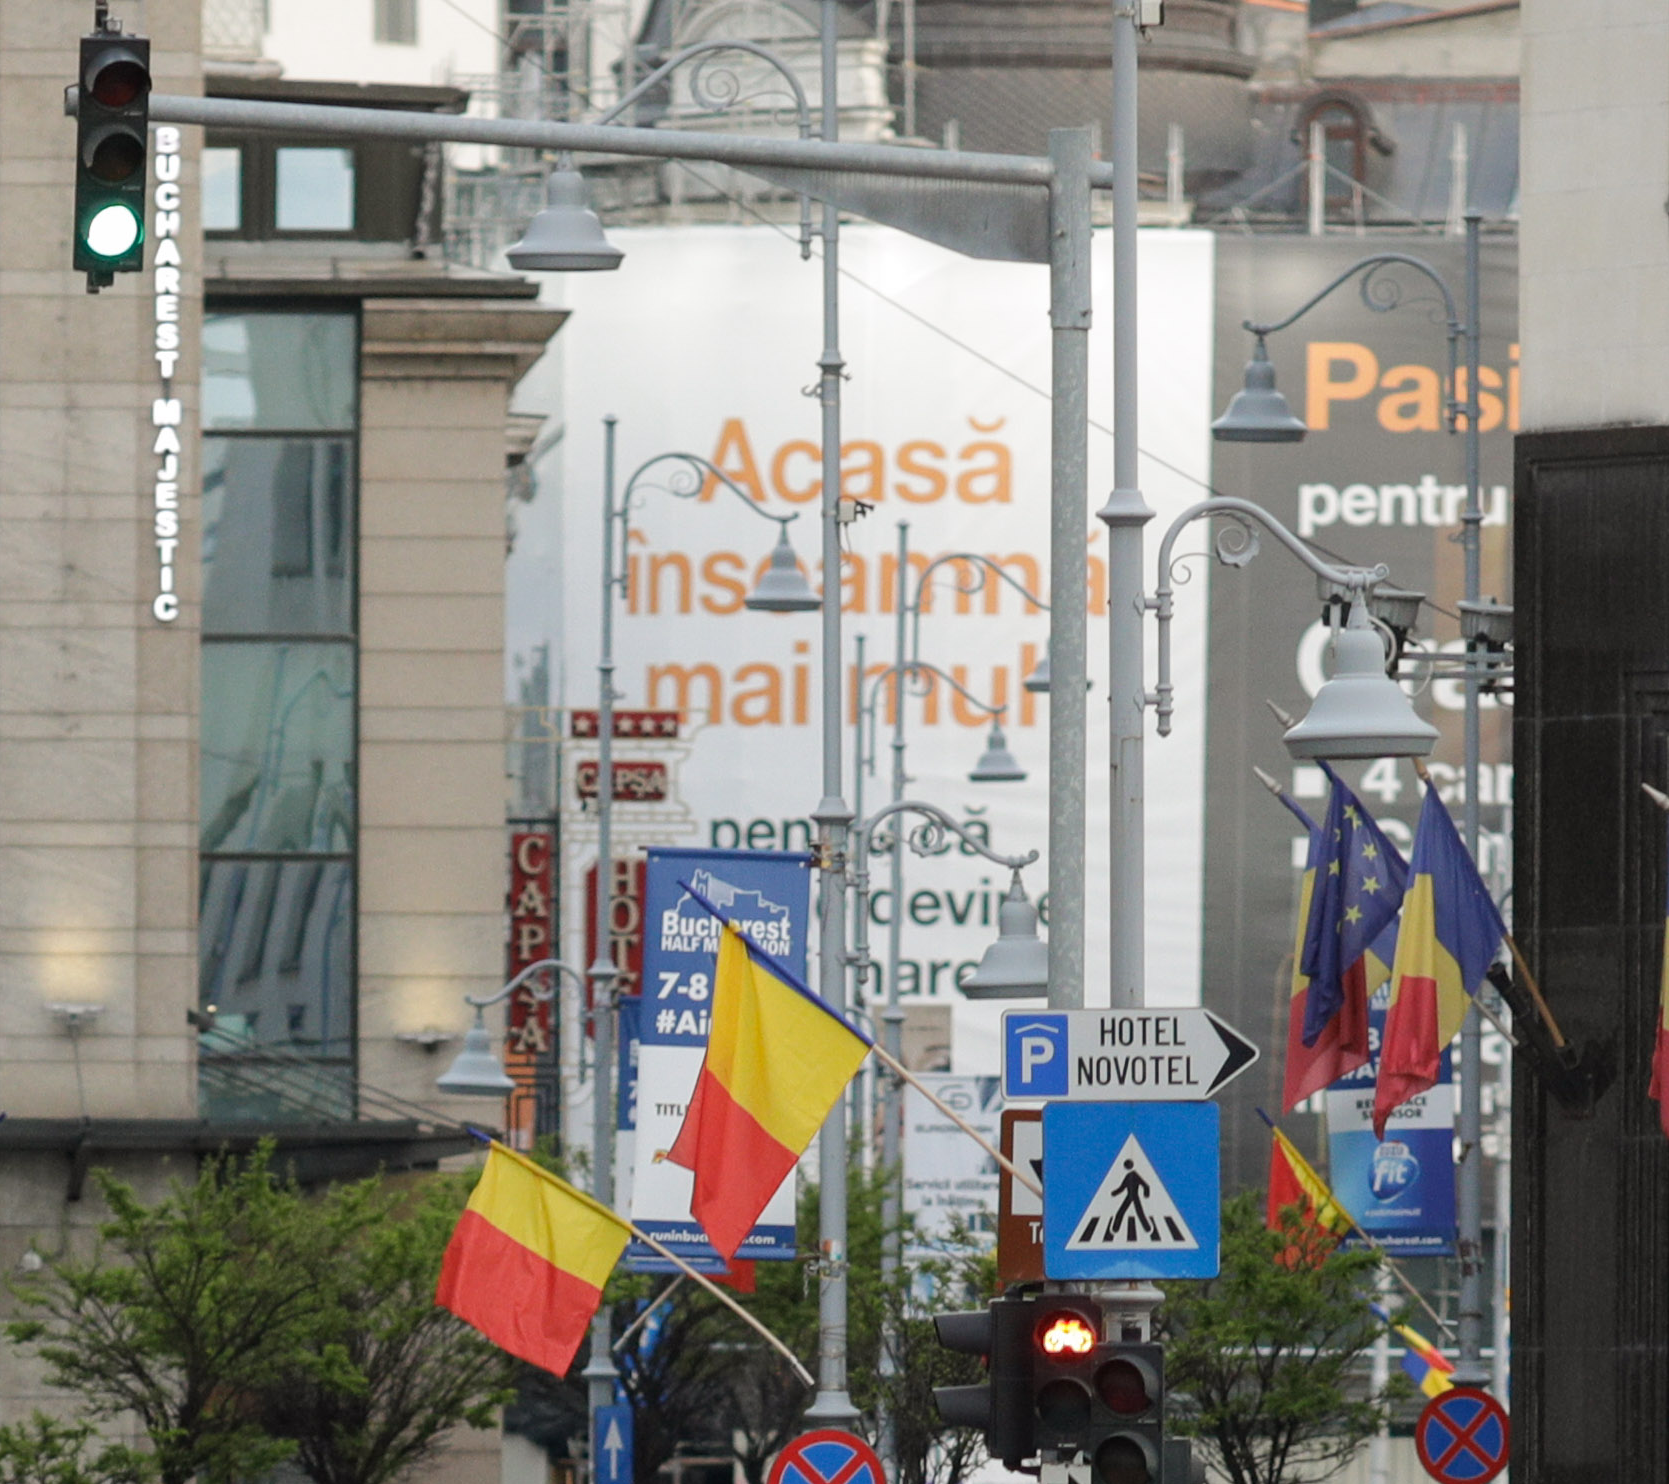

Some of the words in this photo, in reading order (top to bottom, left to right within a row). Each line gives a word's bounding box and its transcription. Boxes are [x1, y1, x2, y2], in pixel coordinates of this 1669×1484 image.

[155, 127, 181, 379] BUCHAREST
[697, 415, 1012, 503] Acasă
[153, 399, 181, 622] MAJESTIC
[1297, 474, 1507, 538] pentru
[625, 530, 1106, 615] însamn
[646, 641, 810, 728] mai
[850, 641, 1038, 728] mul
[612, 859, 641, 997] HOTE
[661, 935, 701, 952] HALF
[663, 909, 792, 941] Buchrest
[657, 972, 709, 1001] 7-8
[1022, 1036, 1055, 1084] P
[1077, 1055, 1199, 1086] NOVOTEL
[1099, 1016, 1186, 1047] HOTEL
[1373, 1160, 1409, 1192] fit
